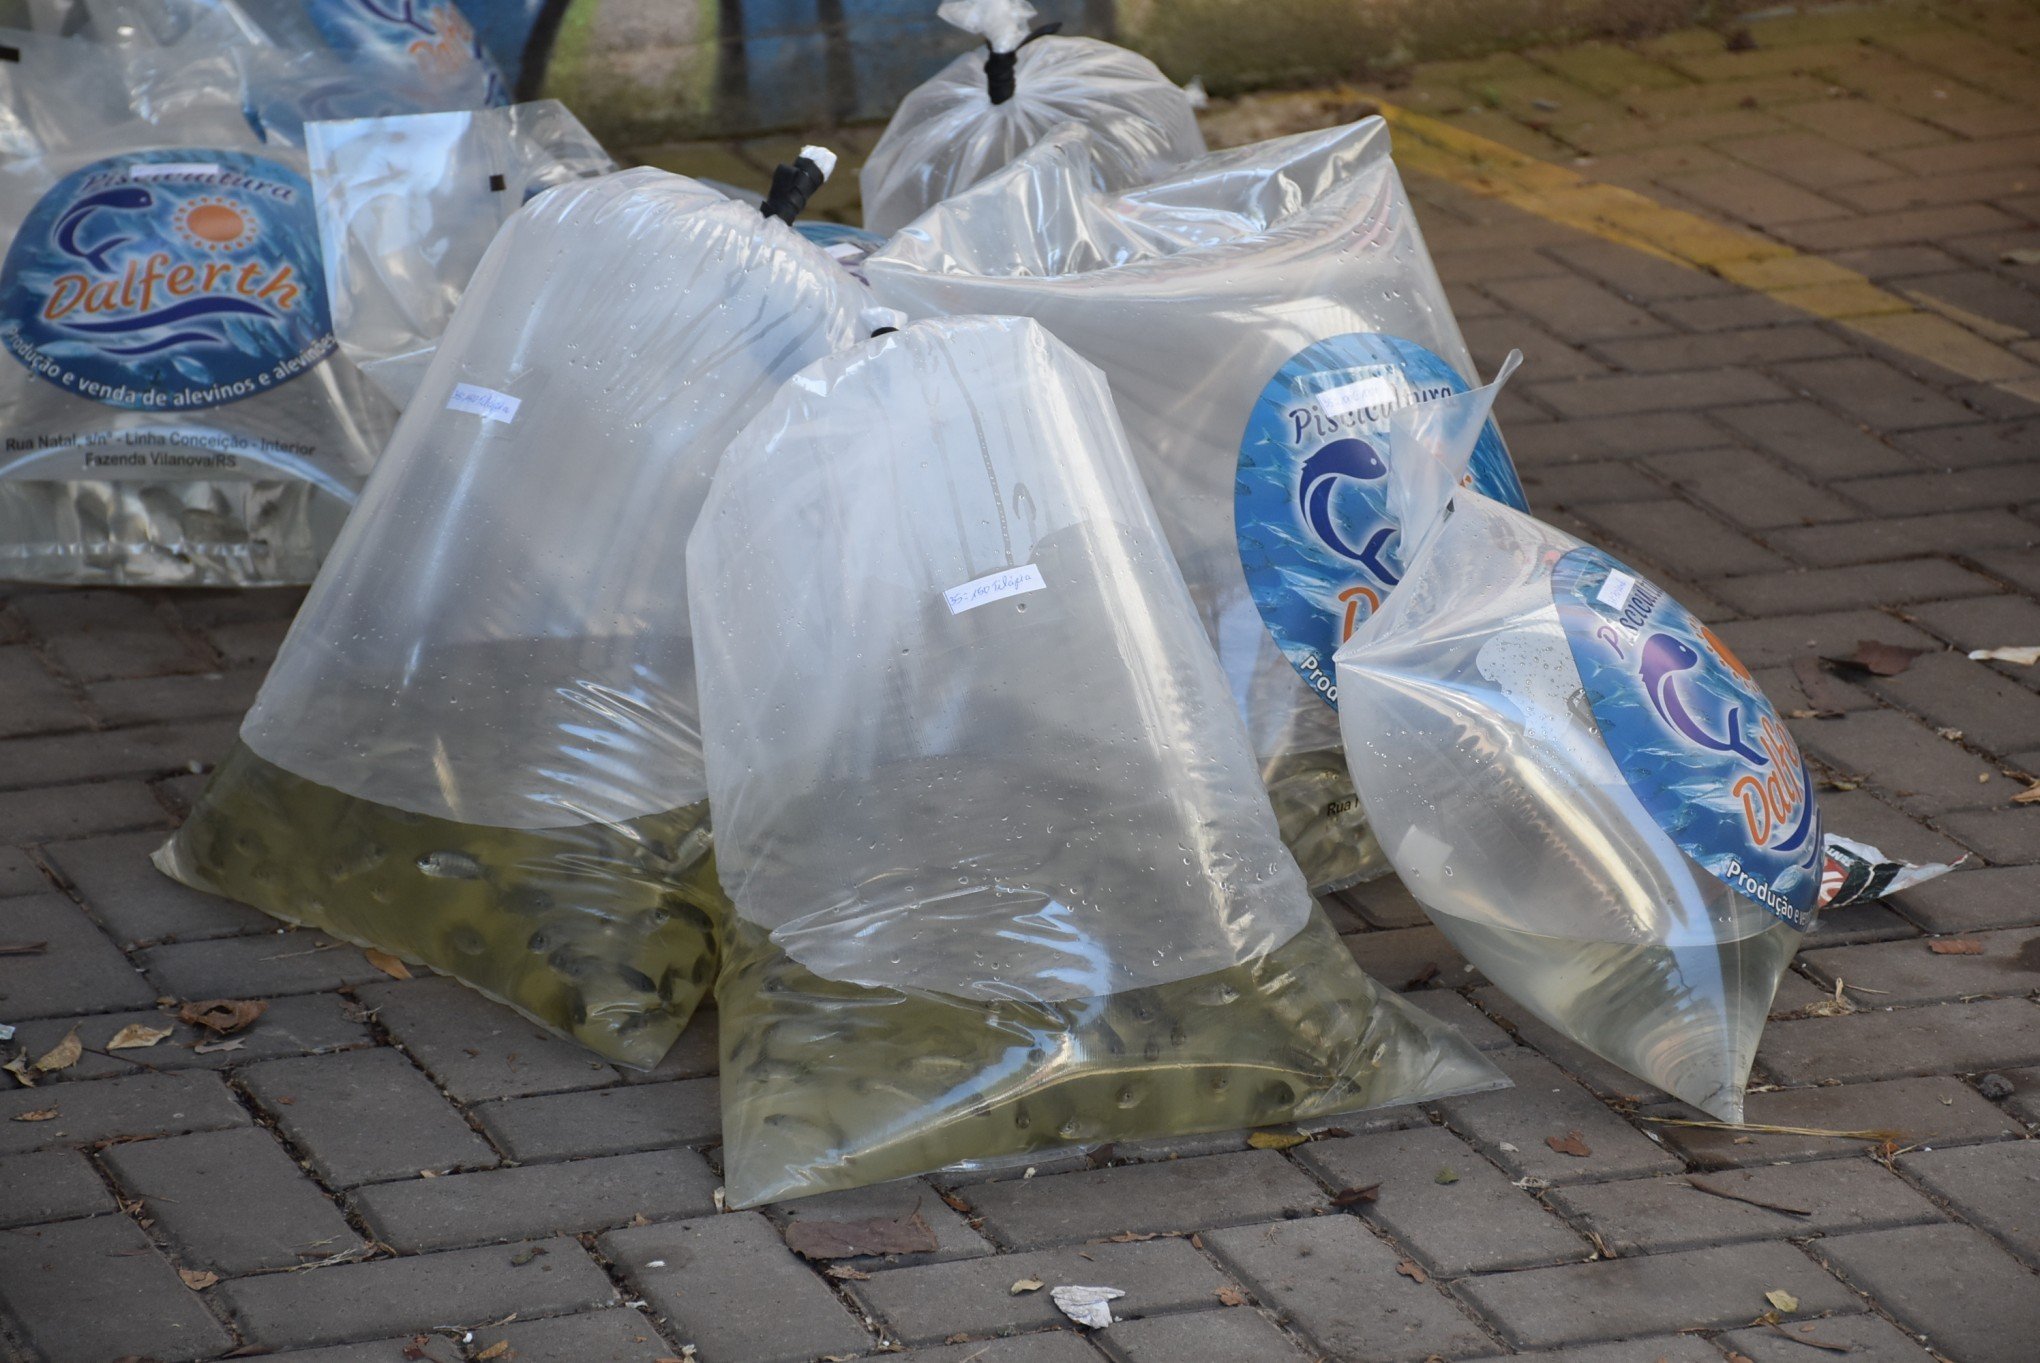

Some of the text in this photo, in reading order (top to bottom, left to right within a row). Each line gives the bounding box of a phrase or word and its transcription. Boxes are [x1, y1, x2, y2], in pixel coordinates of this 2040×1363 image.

[43, 253, 299, 320] Dalferth
[8, 327, 60, 377] Produção
[62, 371, 75, 385] e
[78, 377, 136, 404] venda
[142, 386, 167, 406] de
[173, 377, 256, 406] alevinos
[258, 372, 271, 386] e
[6, 437, 34, 451] Rua
[125, 432, 166, 446] Linha
[169, 431, 248, 451] Conceição
[260, 437, 316, 456] Interior
[85, 452, 236, 467] Fazenda Vilanova/RS
[1327, 800, 1351, 817] Rua
[1726, 860, 1793, 919] Produção
